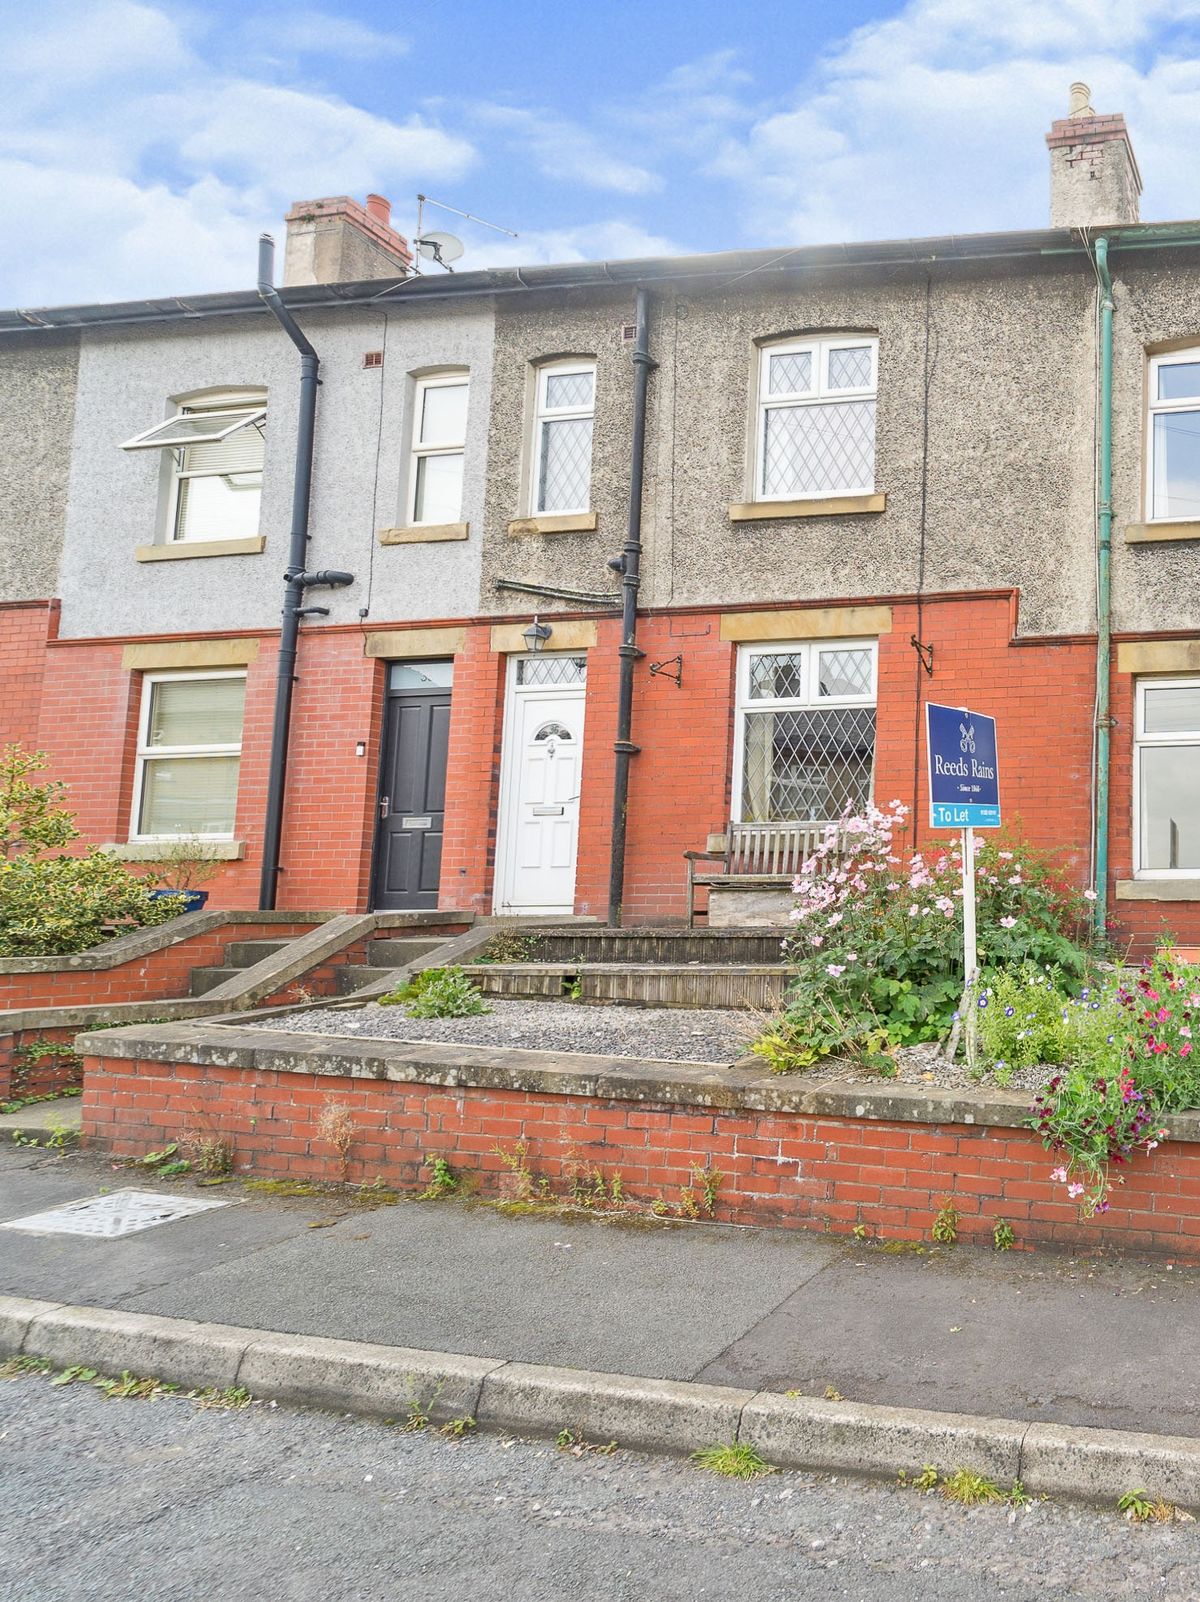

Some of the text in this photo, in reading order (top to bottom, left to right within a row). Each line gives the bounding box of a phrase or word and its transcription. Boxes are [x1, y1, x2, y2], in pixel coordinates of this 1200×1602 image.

[935, 755, 994, 779] Reeds Rains
[938, 807, 951, 822] To
[954, 808, 969, 822] Let
